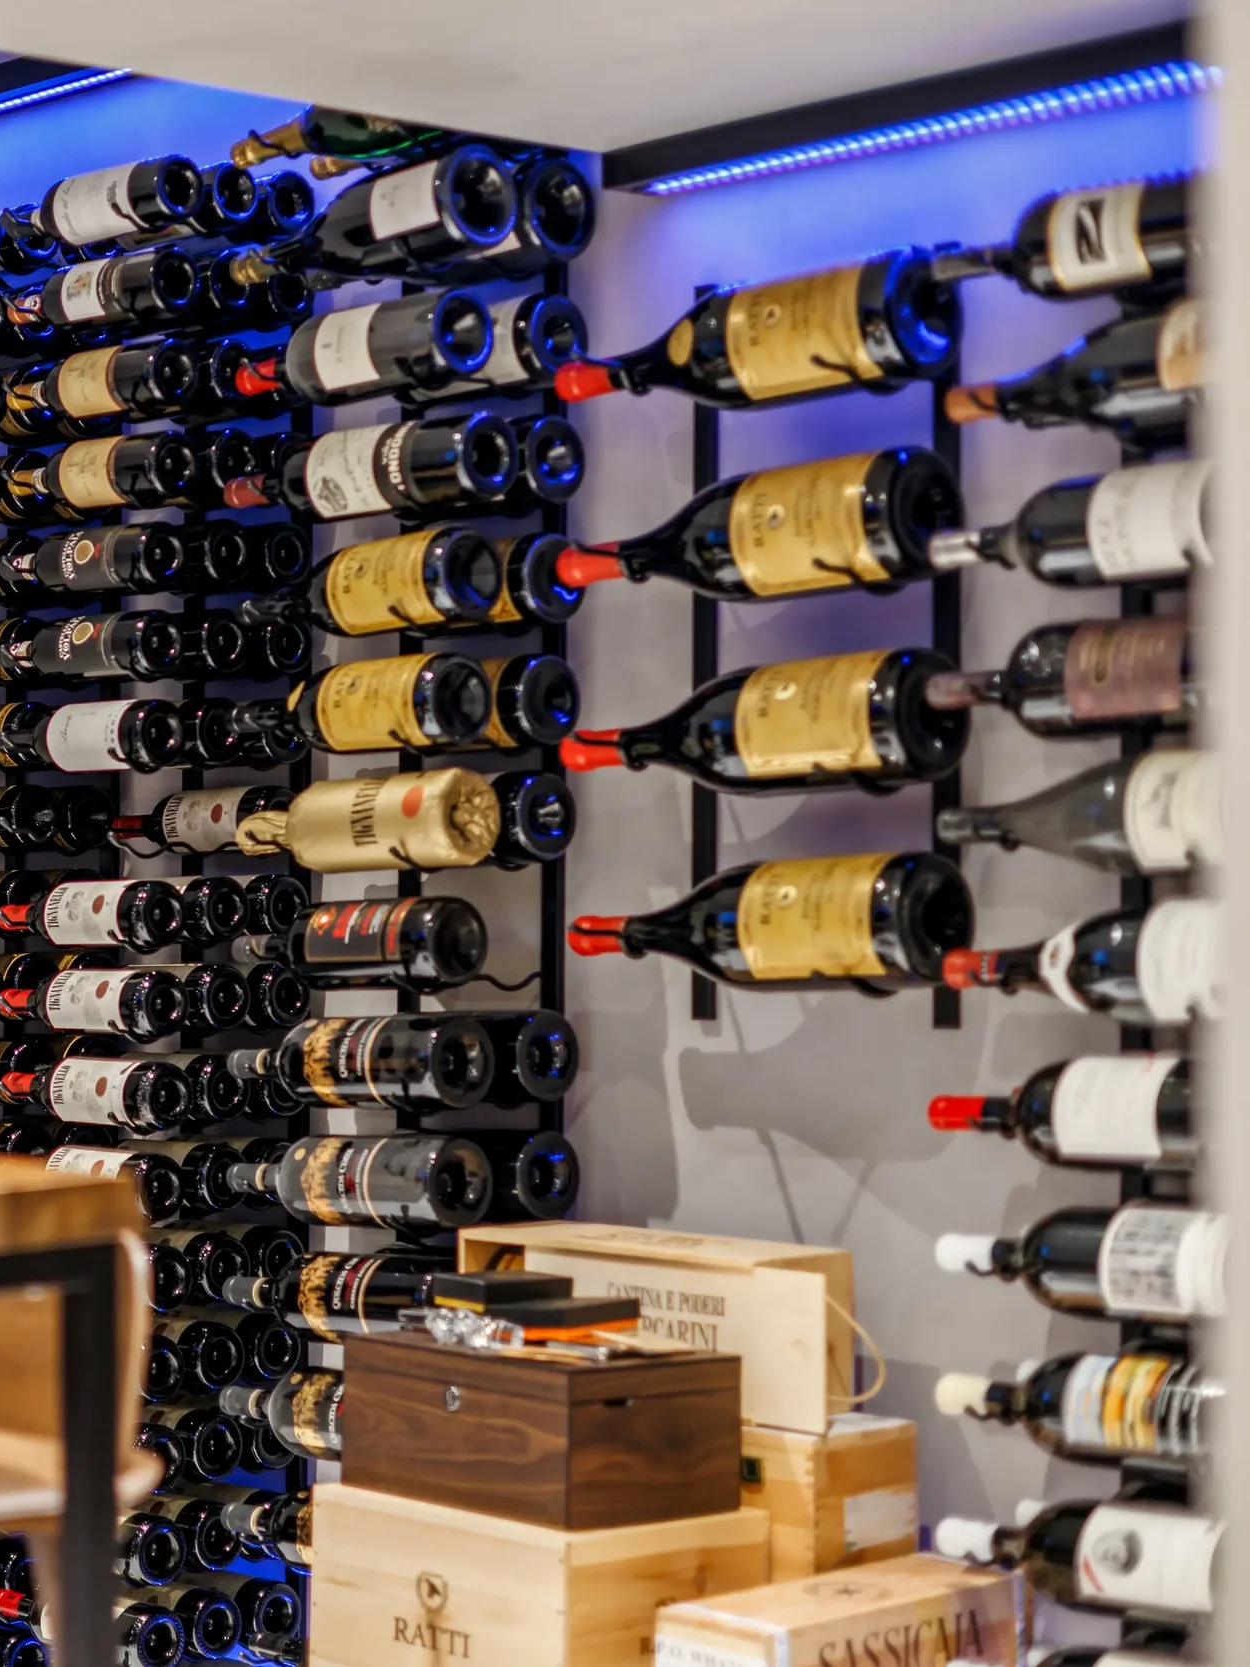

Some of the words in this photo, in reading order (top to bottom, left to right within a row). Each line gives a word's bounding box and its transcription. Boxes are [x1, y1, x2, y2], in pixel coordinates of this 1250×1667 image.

[165, 796, 185, 838] TIGNANELLO
[47, 886, 70, 929] TIGNANELLO
[48, 971, 75, 1011] TIGNANELLO
[53, 1064, 72, 1106] TIGNANELLO
[666, 1290, 674, 1308] E
[679, 1292, 726, 1316] PODERI
[393, 1616, 471, 1659] RATTI
